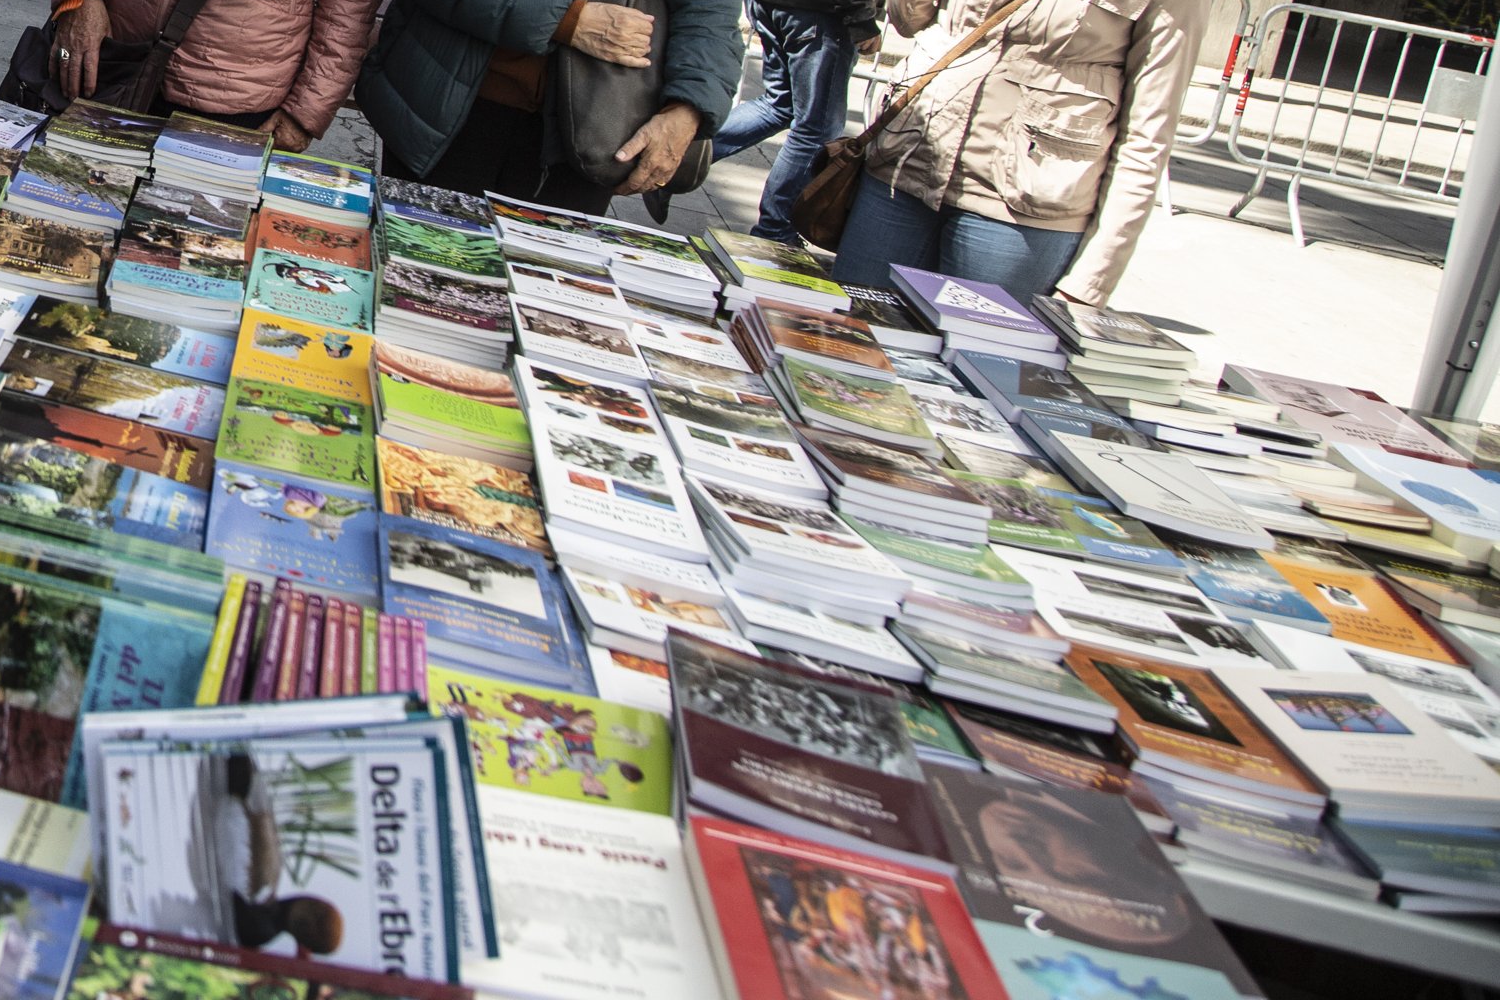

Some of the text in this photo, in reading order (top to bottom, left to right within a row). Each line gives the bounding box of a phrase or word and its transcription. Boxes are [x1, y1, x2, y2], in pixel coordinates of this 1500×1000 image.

[33, 263, 91, 281] Barcelona
[129, 264, 200, 285] Montseny
[115, 644, 143, 688] del
[141, 677, 165, 709] 11
[369, 763, 407, 855] Delta
[376, 860, 399, 890] de
